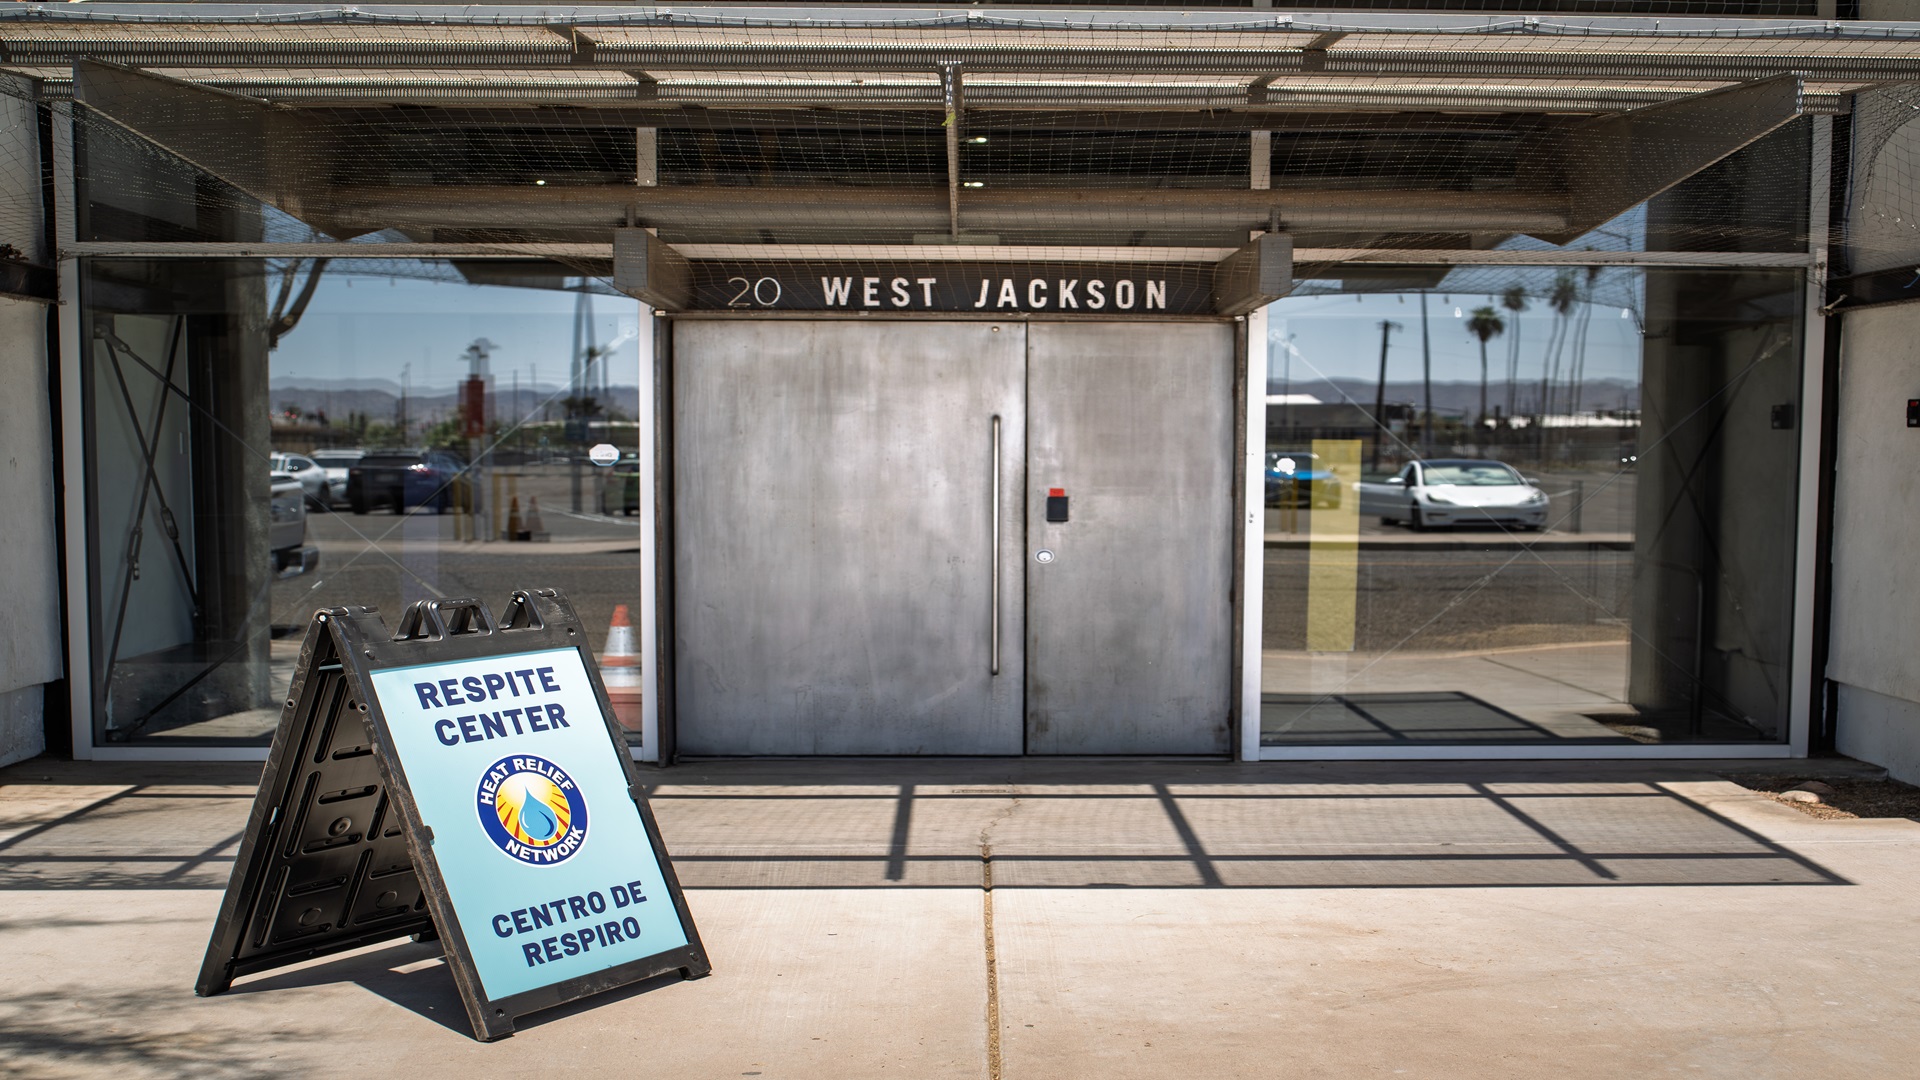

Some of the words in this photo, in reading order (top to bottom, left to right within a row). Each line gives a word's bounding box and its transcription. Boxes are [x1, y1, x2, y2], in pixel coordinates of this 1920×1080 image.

[728, 277, 781, 306] 20
[822, 277, 936, 307] WEST
[974, 278, 1167, 310] JACKSON
[414, 666, 561, 710] RESPITE
[434, 703, 570, 746] CENTER
[480, 762, 509, 805] HEAT
[512, 758, 574, 791] RELIEF
[505, 825, 584, 862] NETWORK
[492, 891, 606, 938] CENTRO
[610, 880, 647, 909] DE
[522, 916, 641, 967] RESPIRO
